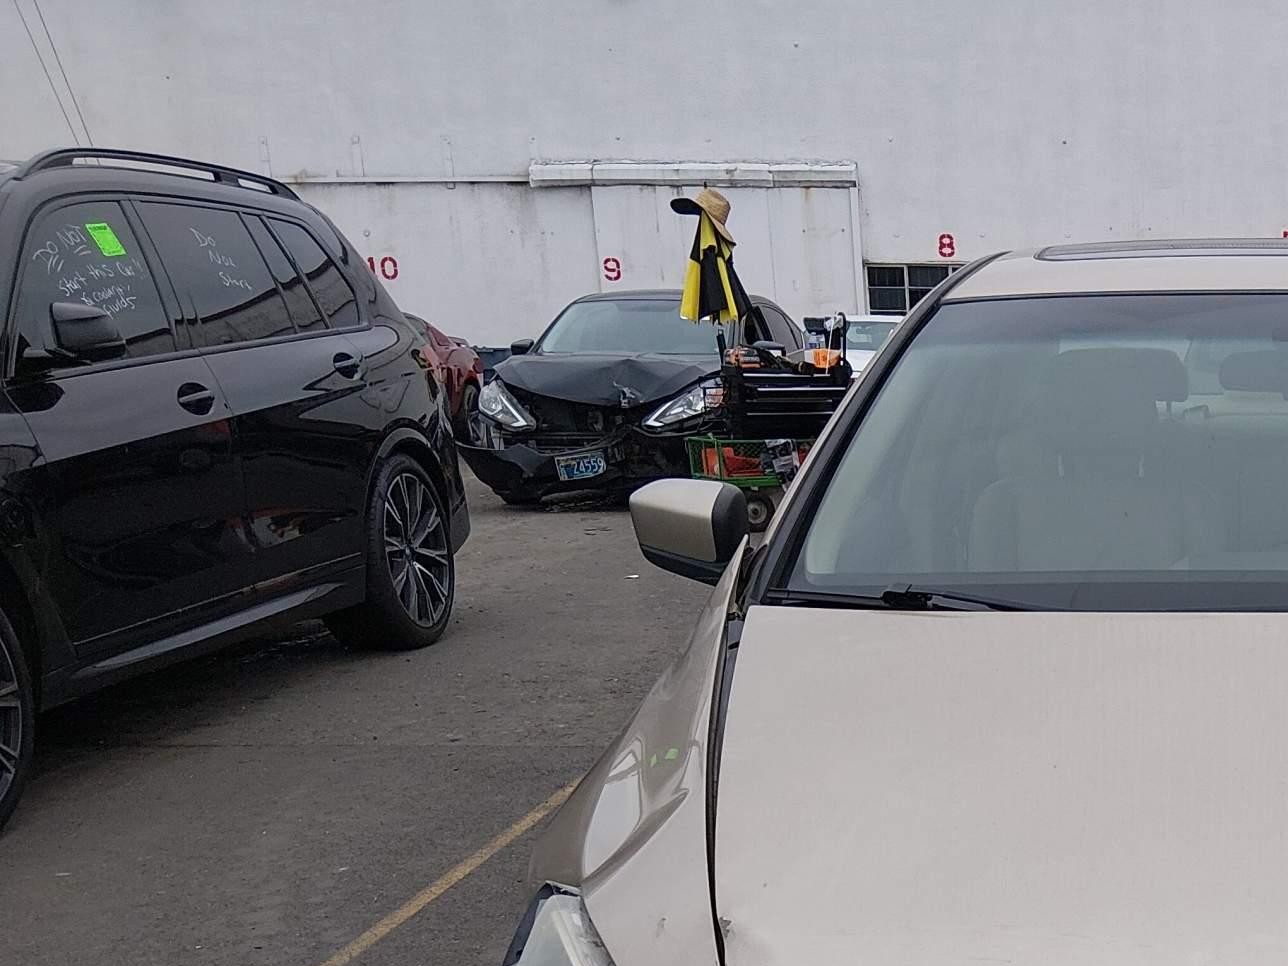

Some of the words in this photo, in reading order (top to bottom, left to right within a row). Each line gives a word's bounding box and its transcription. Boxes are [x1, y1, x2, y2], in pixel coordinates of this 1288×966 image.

[938, 233, 955, 258] 8
[368, 256, 398, 280] 10
[603, 257, 622, 281] 9
